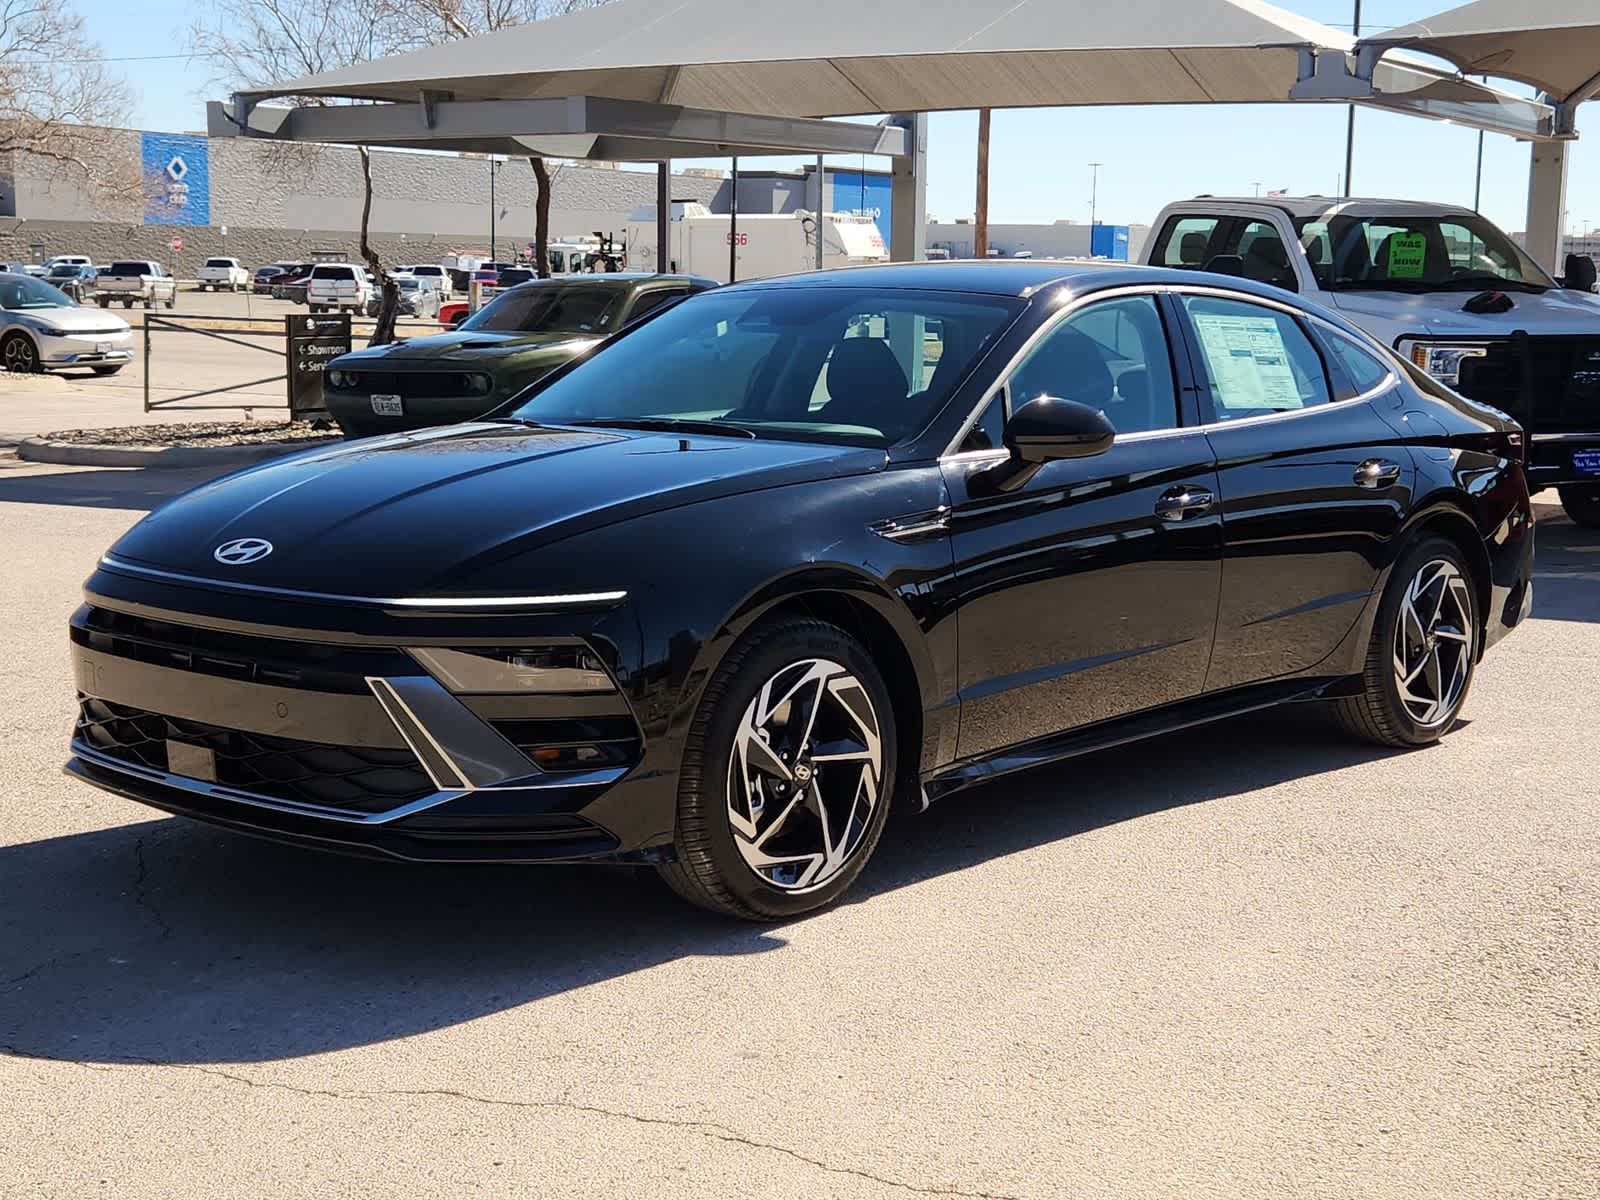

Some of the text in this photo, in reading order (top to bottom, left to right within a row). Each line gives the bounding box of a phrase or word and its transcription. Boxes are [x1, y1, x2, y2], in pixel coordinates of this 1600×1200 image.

[1396, 240, 1422, 248] WAS
[1394, 257, 1421, 265] NOW
[307, 344, 347, 355] Showroom
